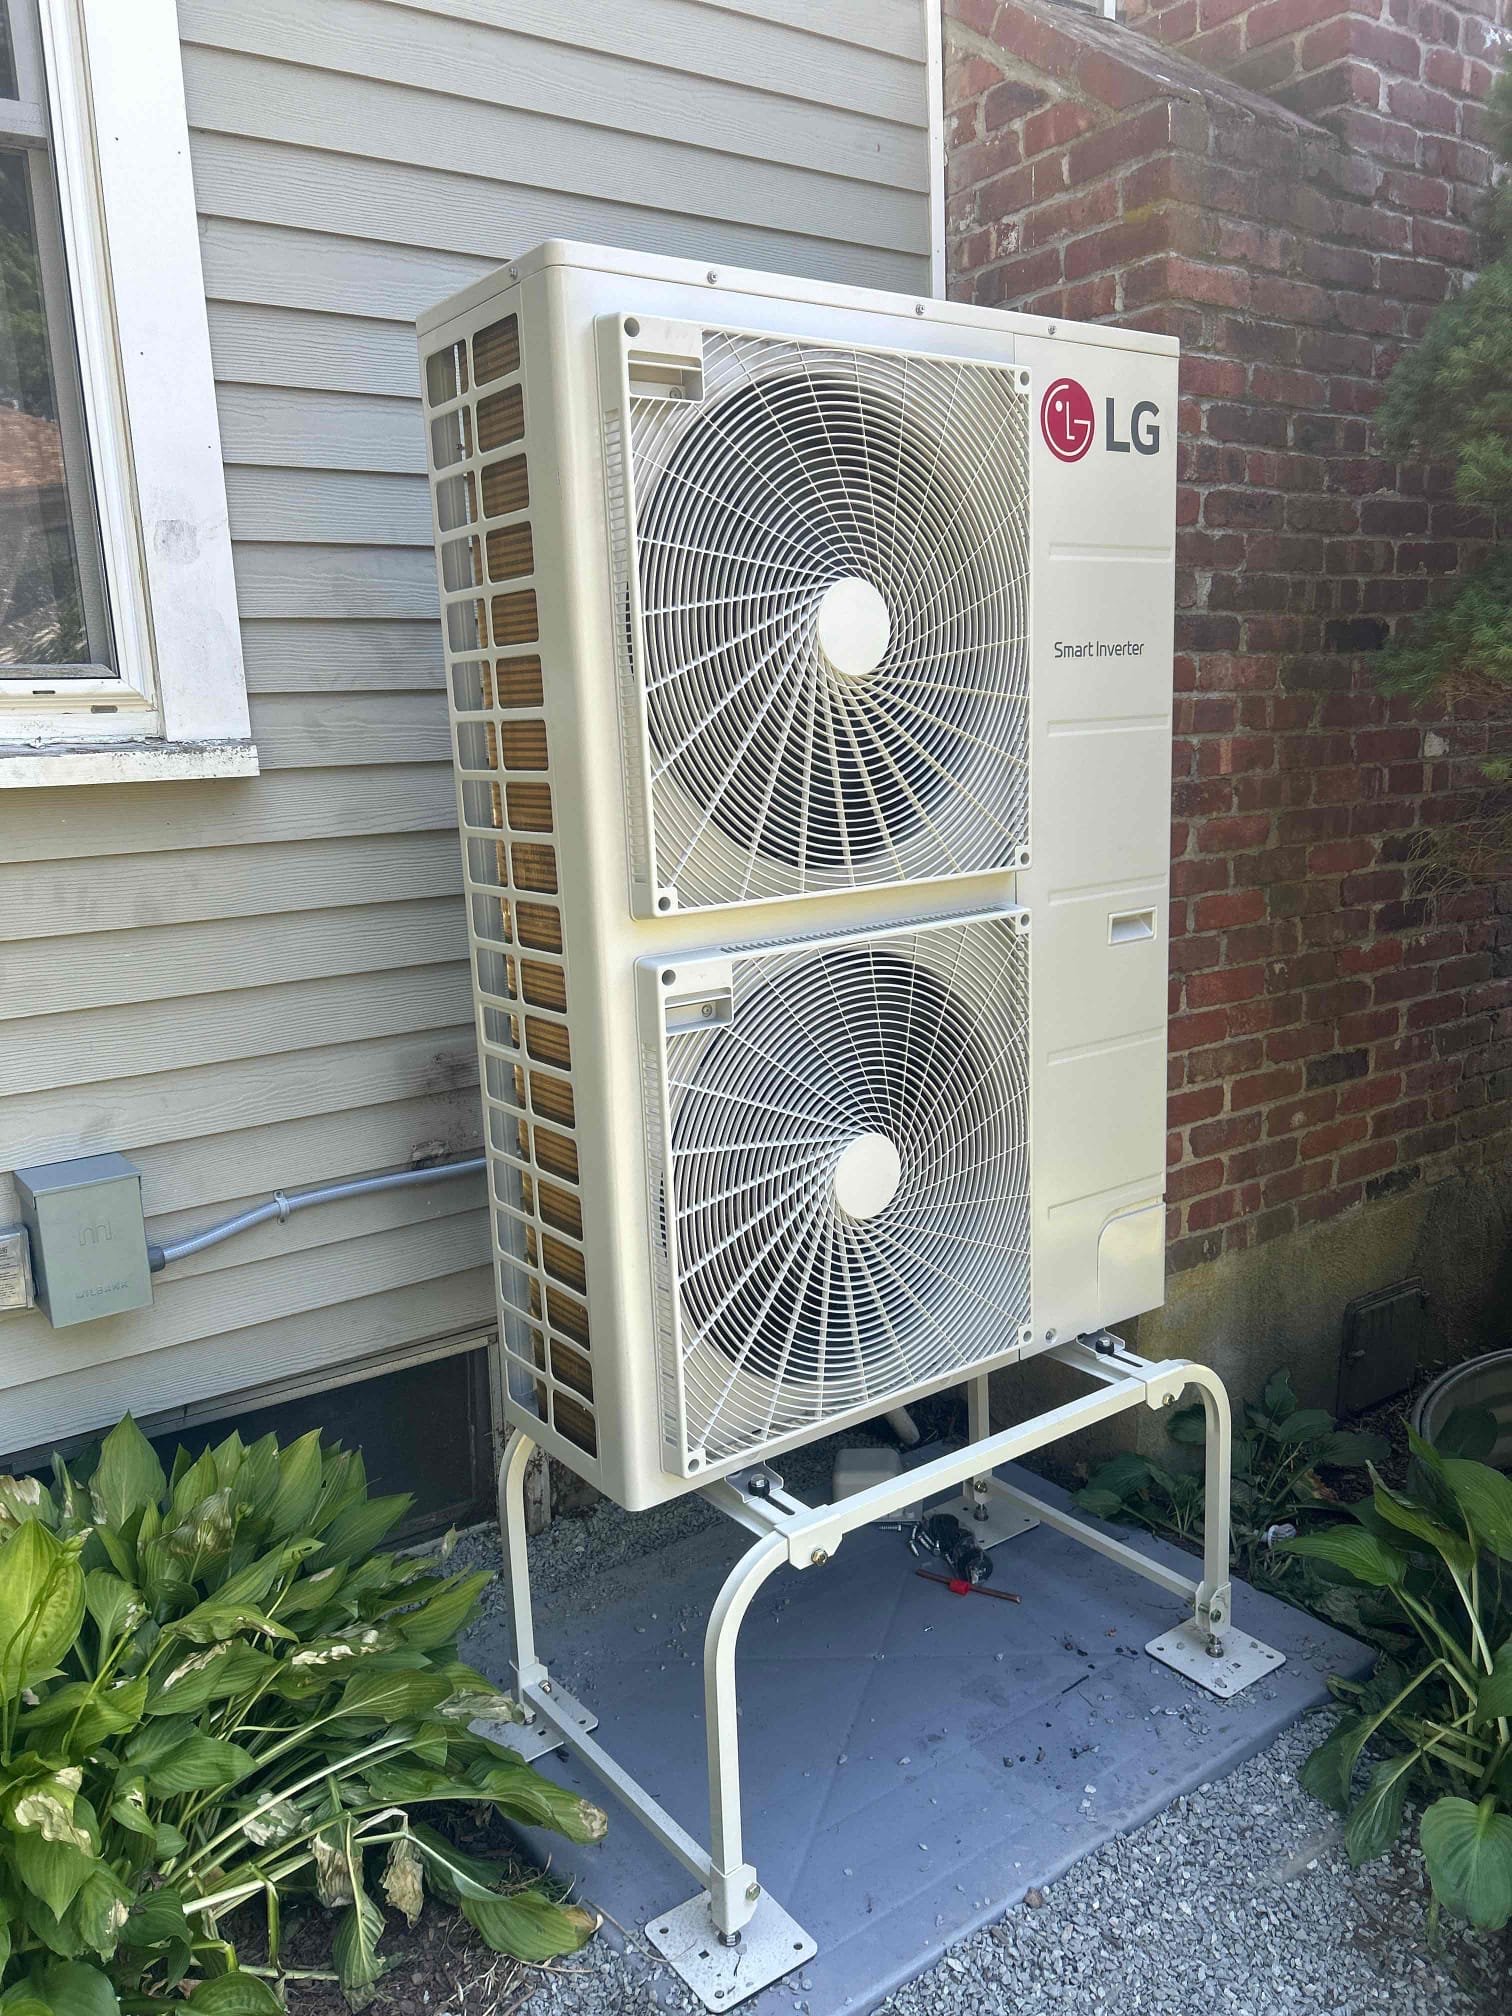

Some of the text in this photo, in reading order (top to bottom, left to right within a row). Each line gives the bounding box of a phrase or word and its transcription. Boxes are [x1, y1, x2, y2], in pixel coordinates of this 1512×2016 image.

[1105, 397, 1160, 455] LG
[1054, 640, 1144, 658] Smart Inverter
